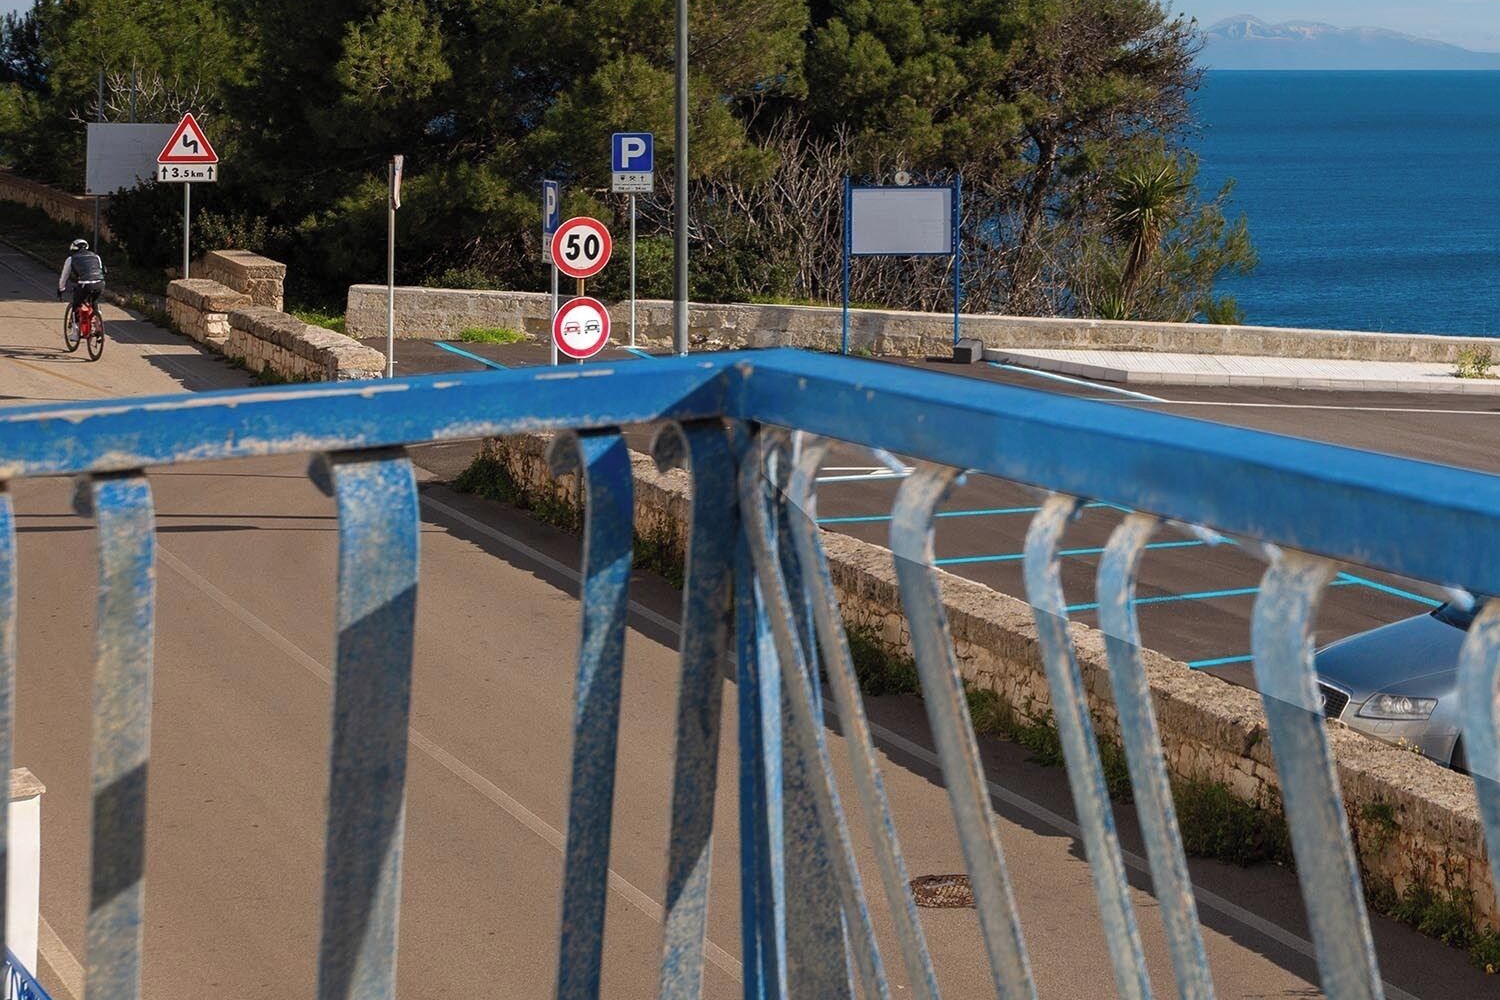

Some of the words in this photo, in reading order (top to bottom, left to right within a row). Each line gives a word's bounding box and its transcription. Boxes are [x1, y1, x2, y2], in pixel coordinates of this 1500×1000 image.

[621, 137, 646, 168] P
[171, 167, 190, 178] 3.5
[190, 170, 204, 178] km
[546, 186, 556, 229] P
[565, 234, 600, 261] 50
